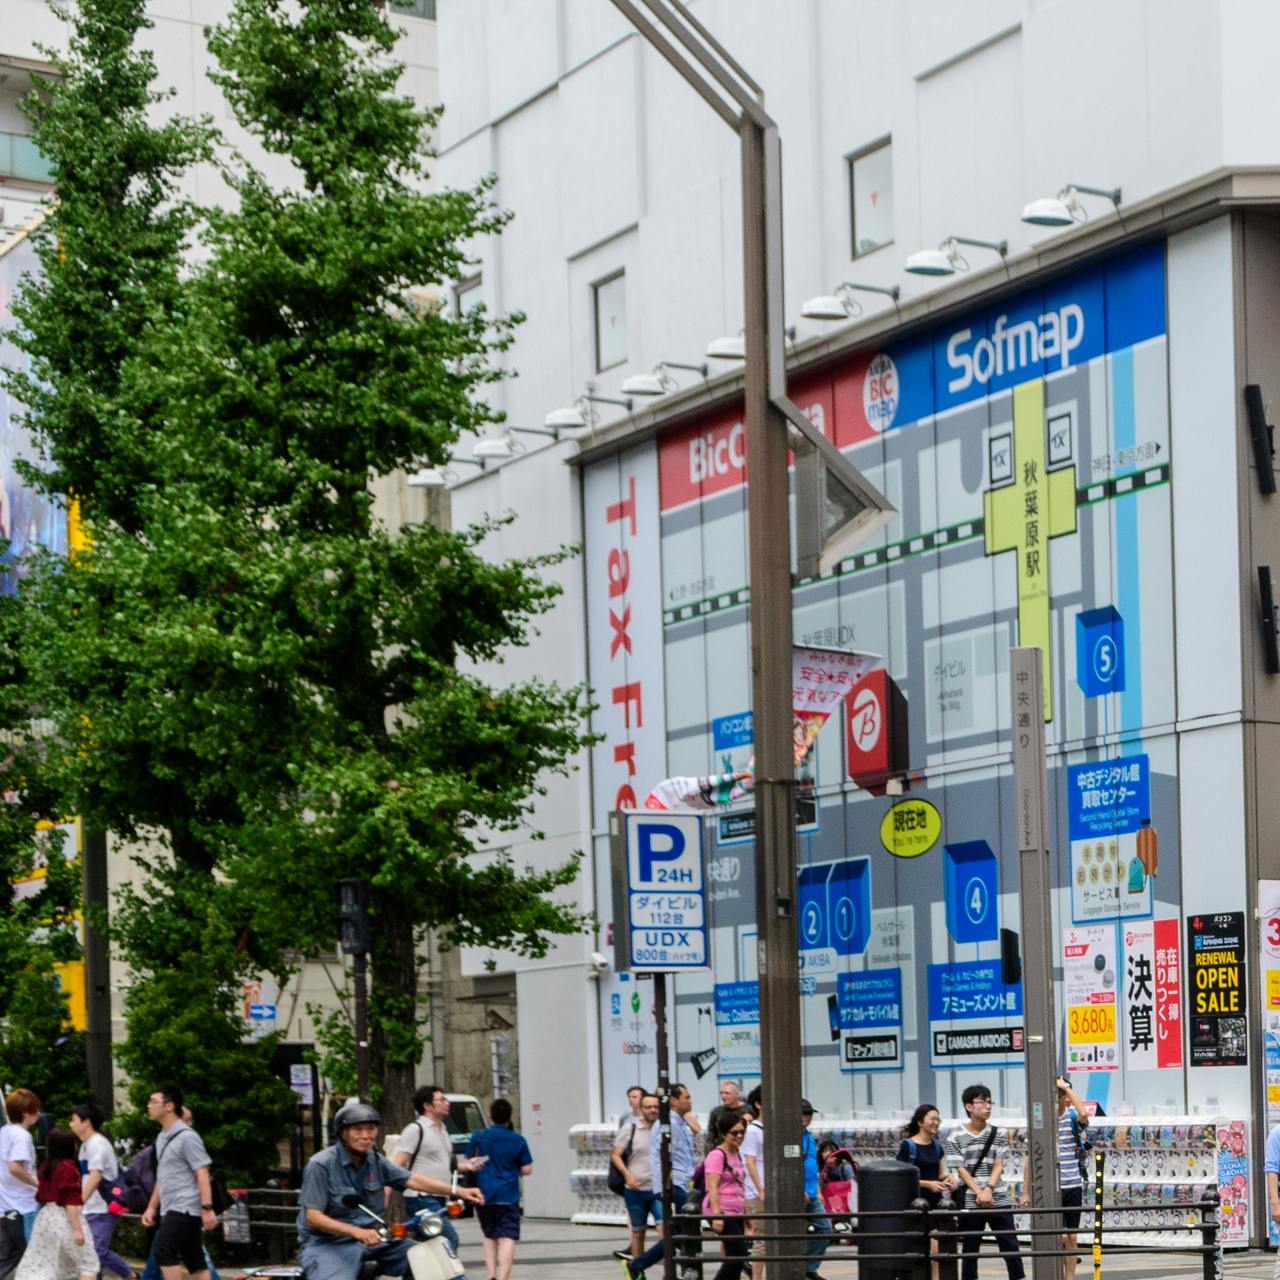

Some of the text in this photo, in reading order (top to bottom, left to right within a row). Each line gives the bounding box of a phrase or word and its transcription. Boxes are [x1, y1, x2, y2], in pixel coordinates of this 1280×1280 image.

[946, 303, 1086, 394] Sofmap
[1022, 460, 1041, 579] 秋葉原駅
[605, 476, 638, 661] Tax
[1099, 645, 1111, 673] 5
[1016, 670, 1031, 749] 中央通り
[1076, 763, 1141, 790] 中古デジタル館
[893, 807, 928, 834] 現在地
[636, 823, 687, 883] P
[656, 868, 693, 883] 24H
[635, 895, 697, 911] ダイビル
[971, 886, 982, 913] 4
[649, 911, 685, 925] 112台
[807, 910, 817, 936] 2
[840, 907, 848, 932] 1
[645, 931, 690, 947] UDX
[1195, 951, 1238, 966] RENEWAL
[1167, 947, 1180, 1021] 在庫一掃
[1196, 966, 1239, 990] OPEN
[1127, 953, 1155, 1052] 決算
[1155, 949, 1169, 1041] 売りつくし
[1196, 990, 1239, 1014] SALE
